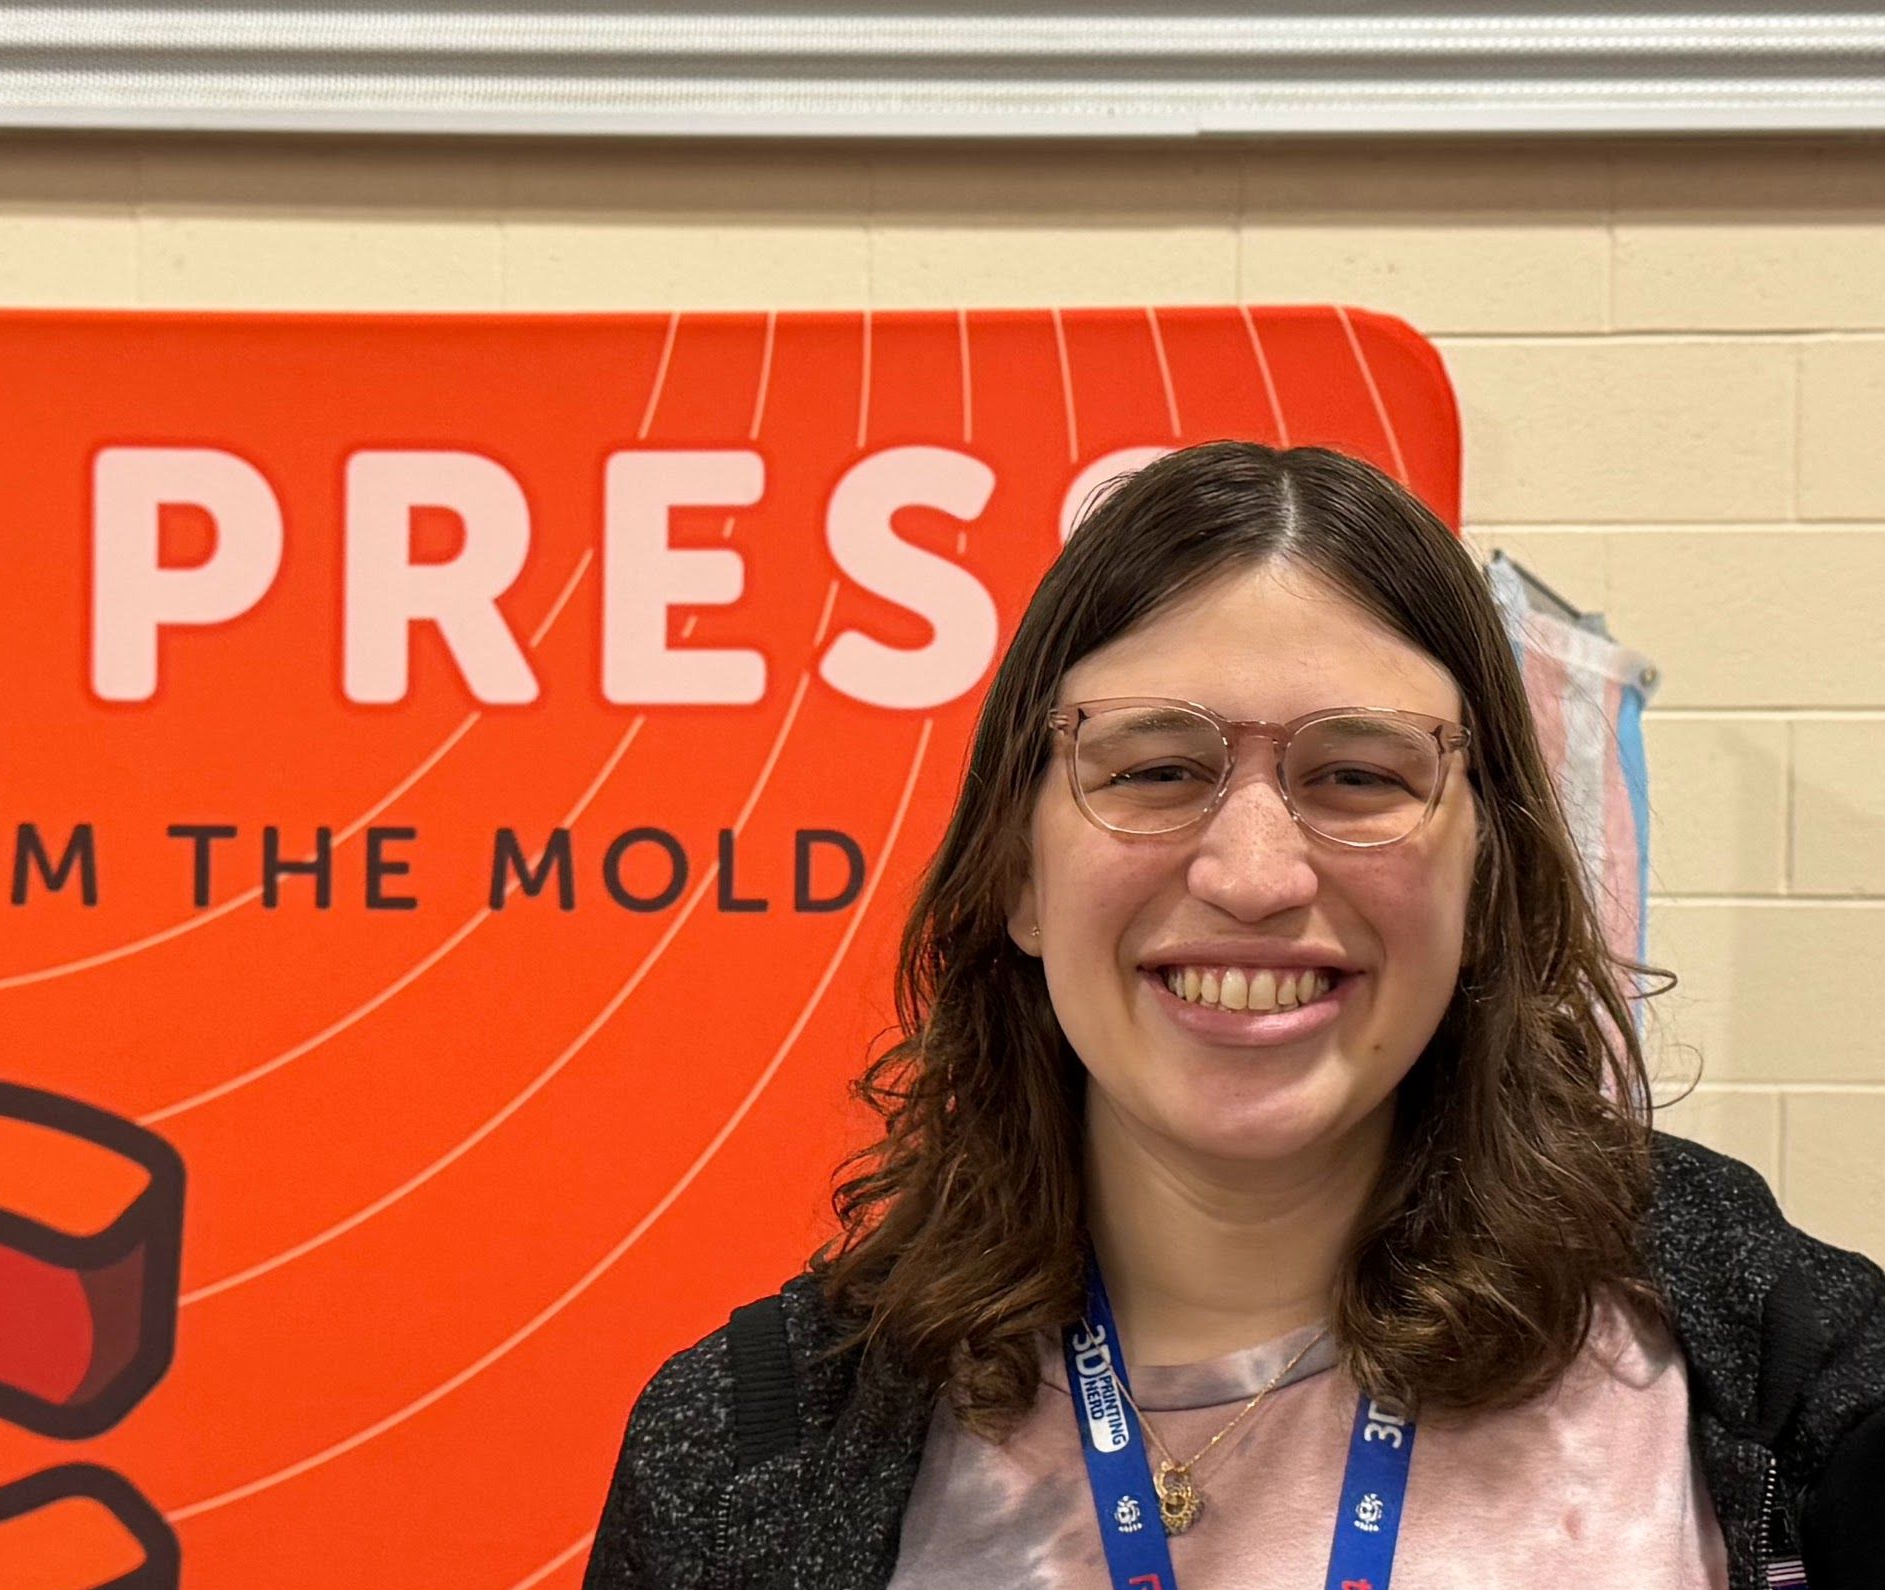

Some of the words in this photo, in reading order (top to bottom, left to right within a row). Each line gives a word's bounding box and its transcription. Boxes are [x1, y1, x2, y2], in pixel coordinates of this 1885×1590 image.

[91, 445, 1186, 710] PRES
[166, 823, 418, 912] THE
[487, 826, 868, 914] MOLD
[1082, 1378, 1104, 1422] NERD
[1100, 1374, 1128, 1447] PRINTING
